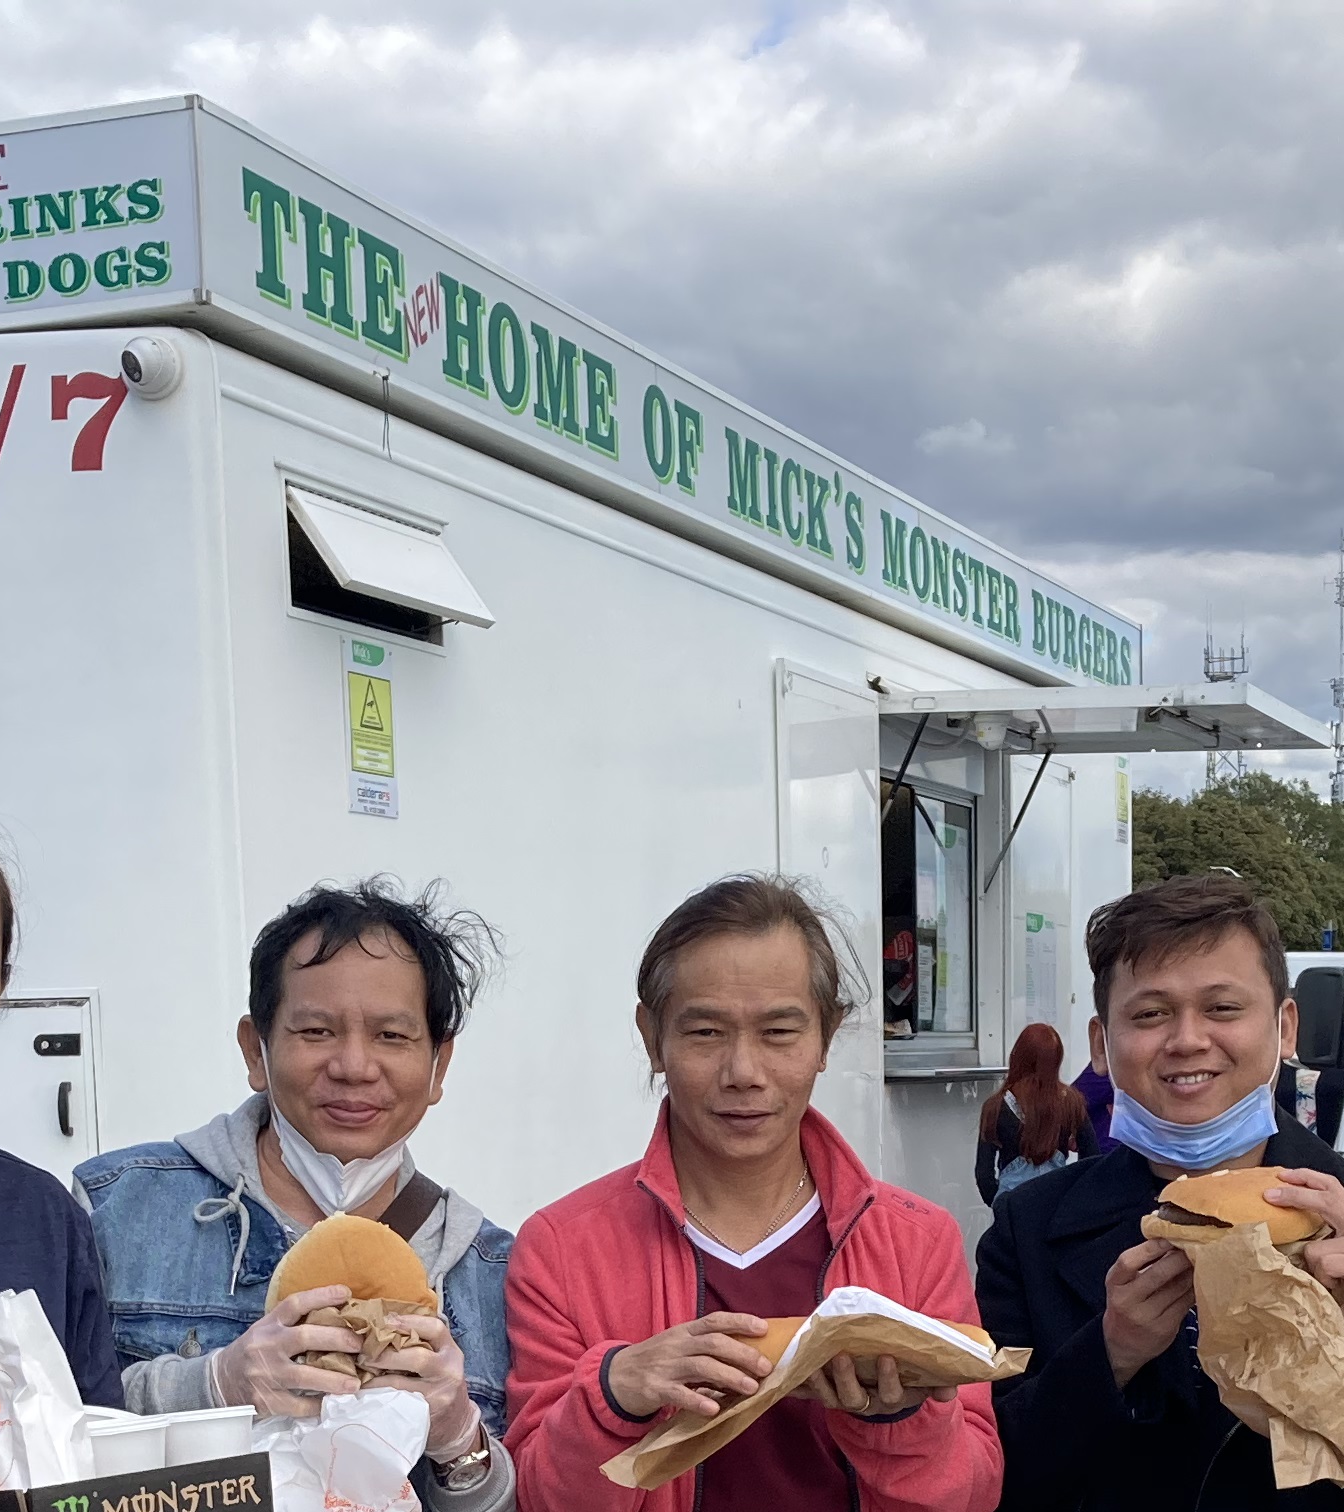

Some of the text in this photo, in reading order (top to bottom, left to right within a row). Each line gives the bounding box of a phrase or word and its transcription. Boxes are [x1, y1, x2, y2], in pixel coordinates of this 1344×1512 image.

[4, 241, 172, 303] DOGS
[403, 270, 440, 358] NEW
[242, 166, 1132, 687] THE HOME OF MICK'S MONSTER BURGERS
